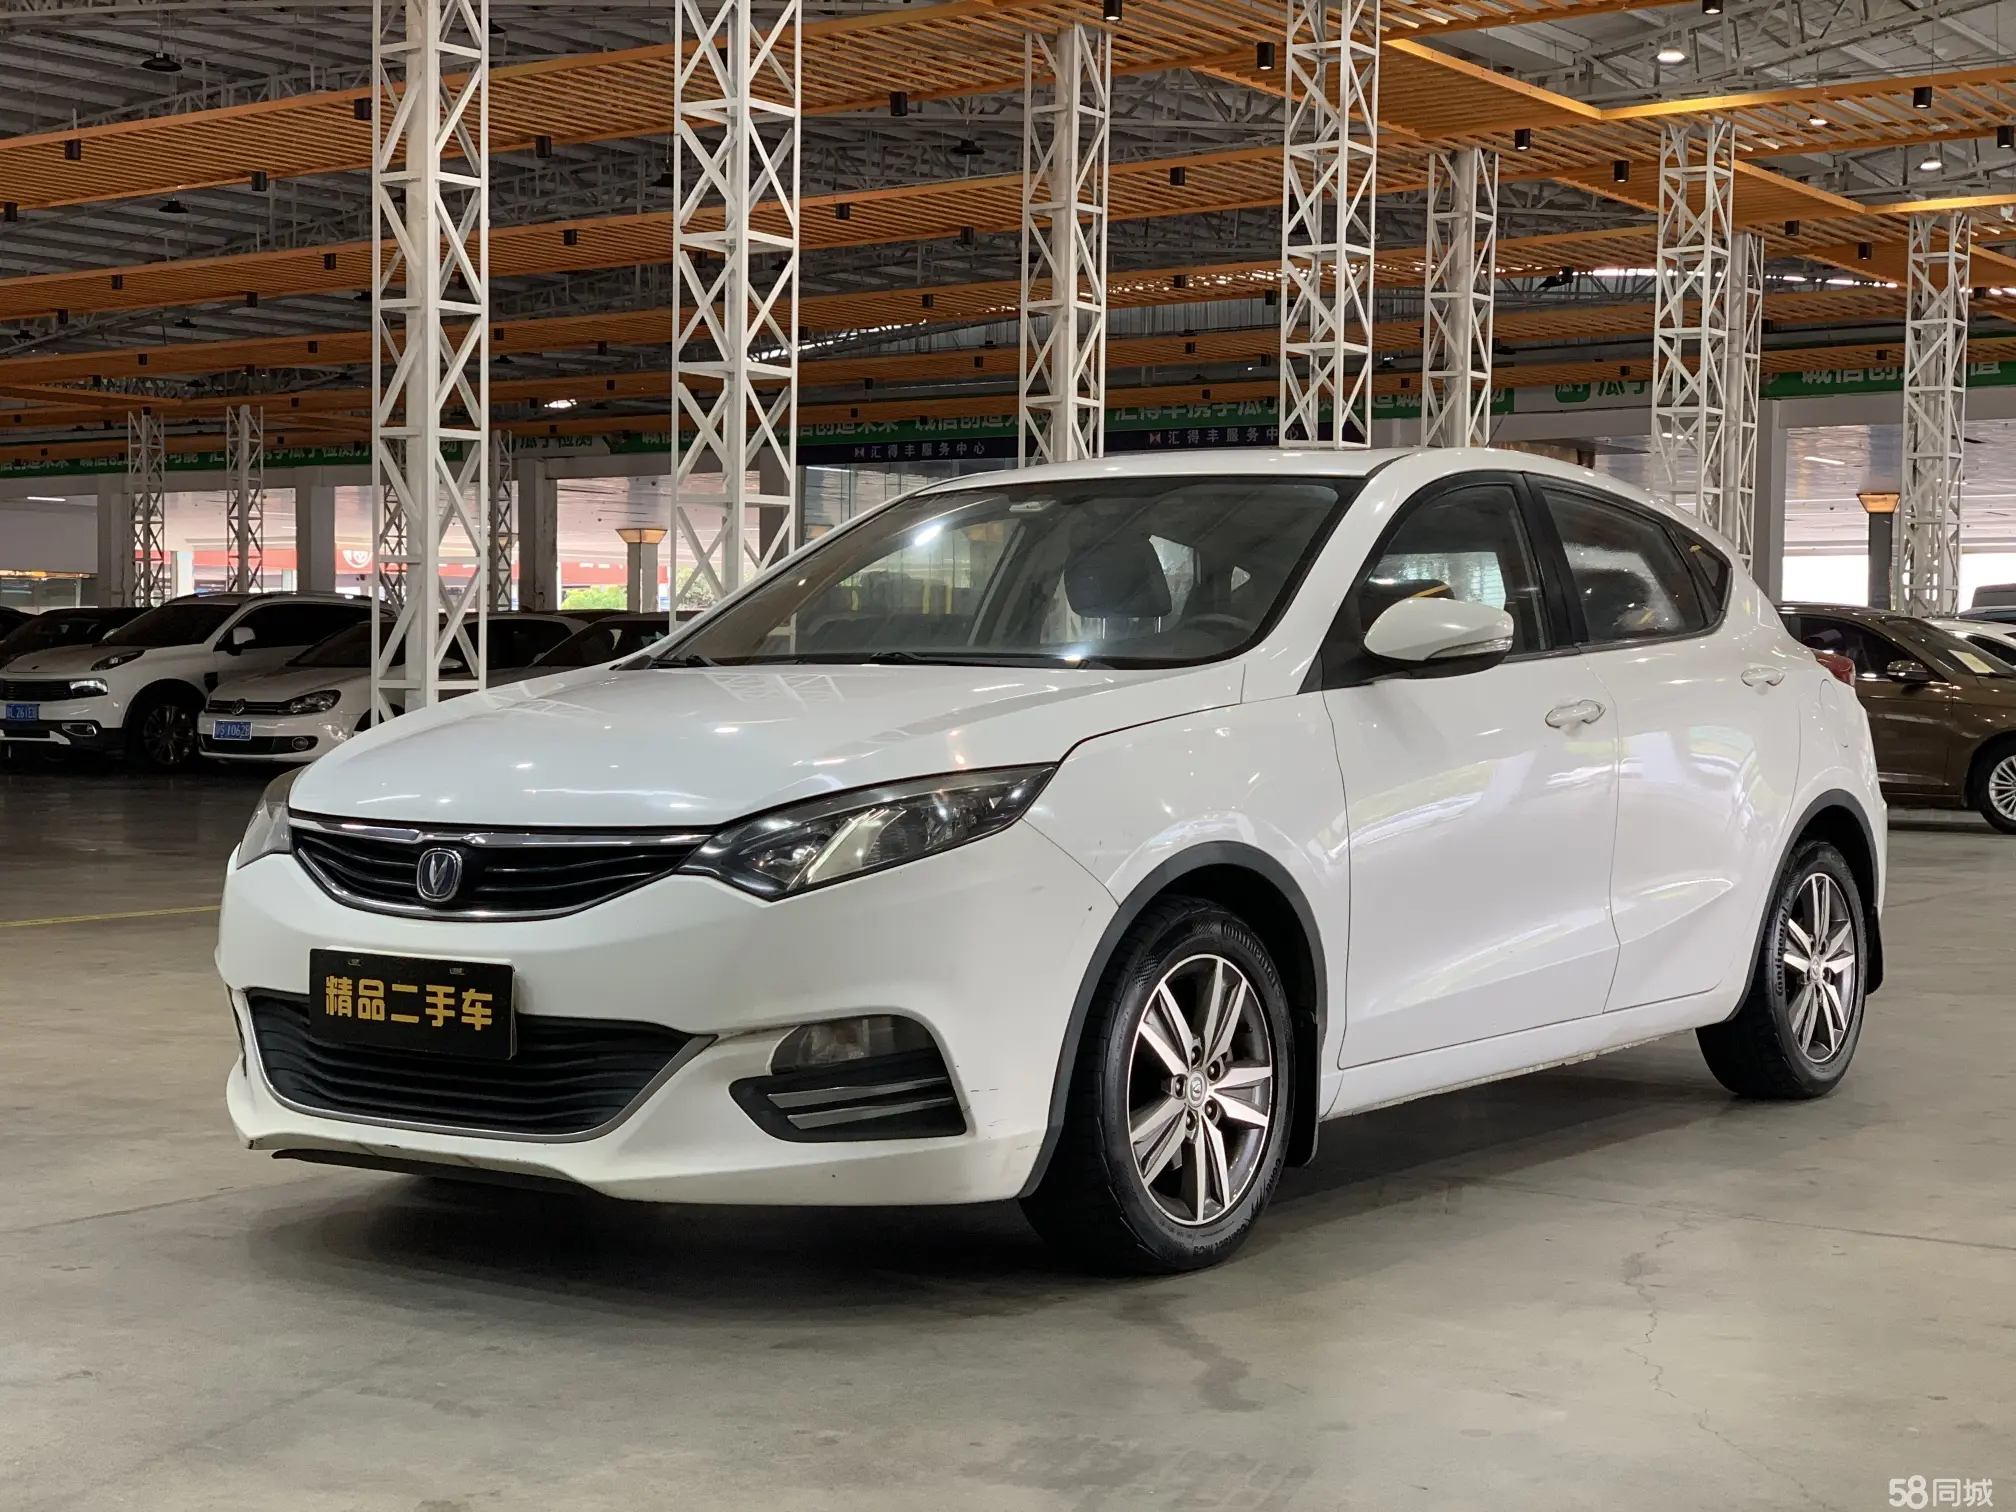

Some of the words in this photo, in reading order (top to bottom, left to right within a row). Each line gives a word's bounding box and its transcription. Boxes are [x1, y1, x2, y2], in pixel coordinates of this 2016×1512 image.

[871, 441, 986, 459] 汇得丰服务中心
[325, 975, 493, 1031] 精品二手车
